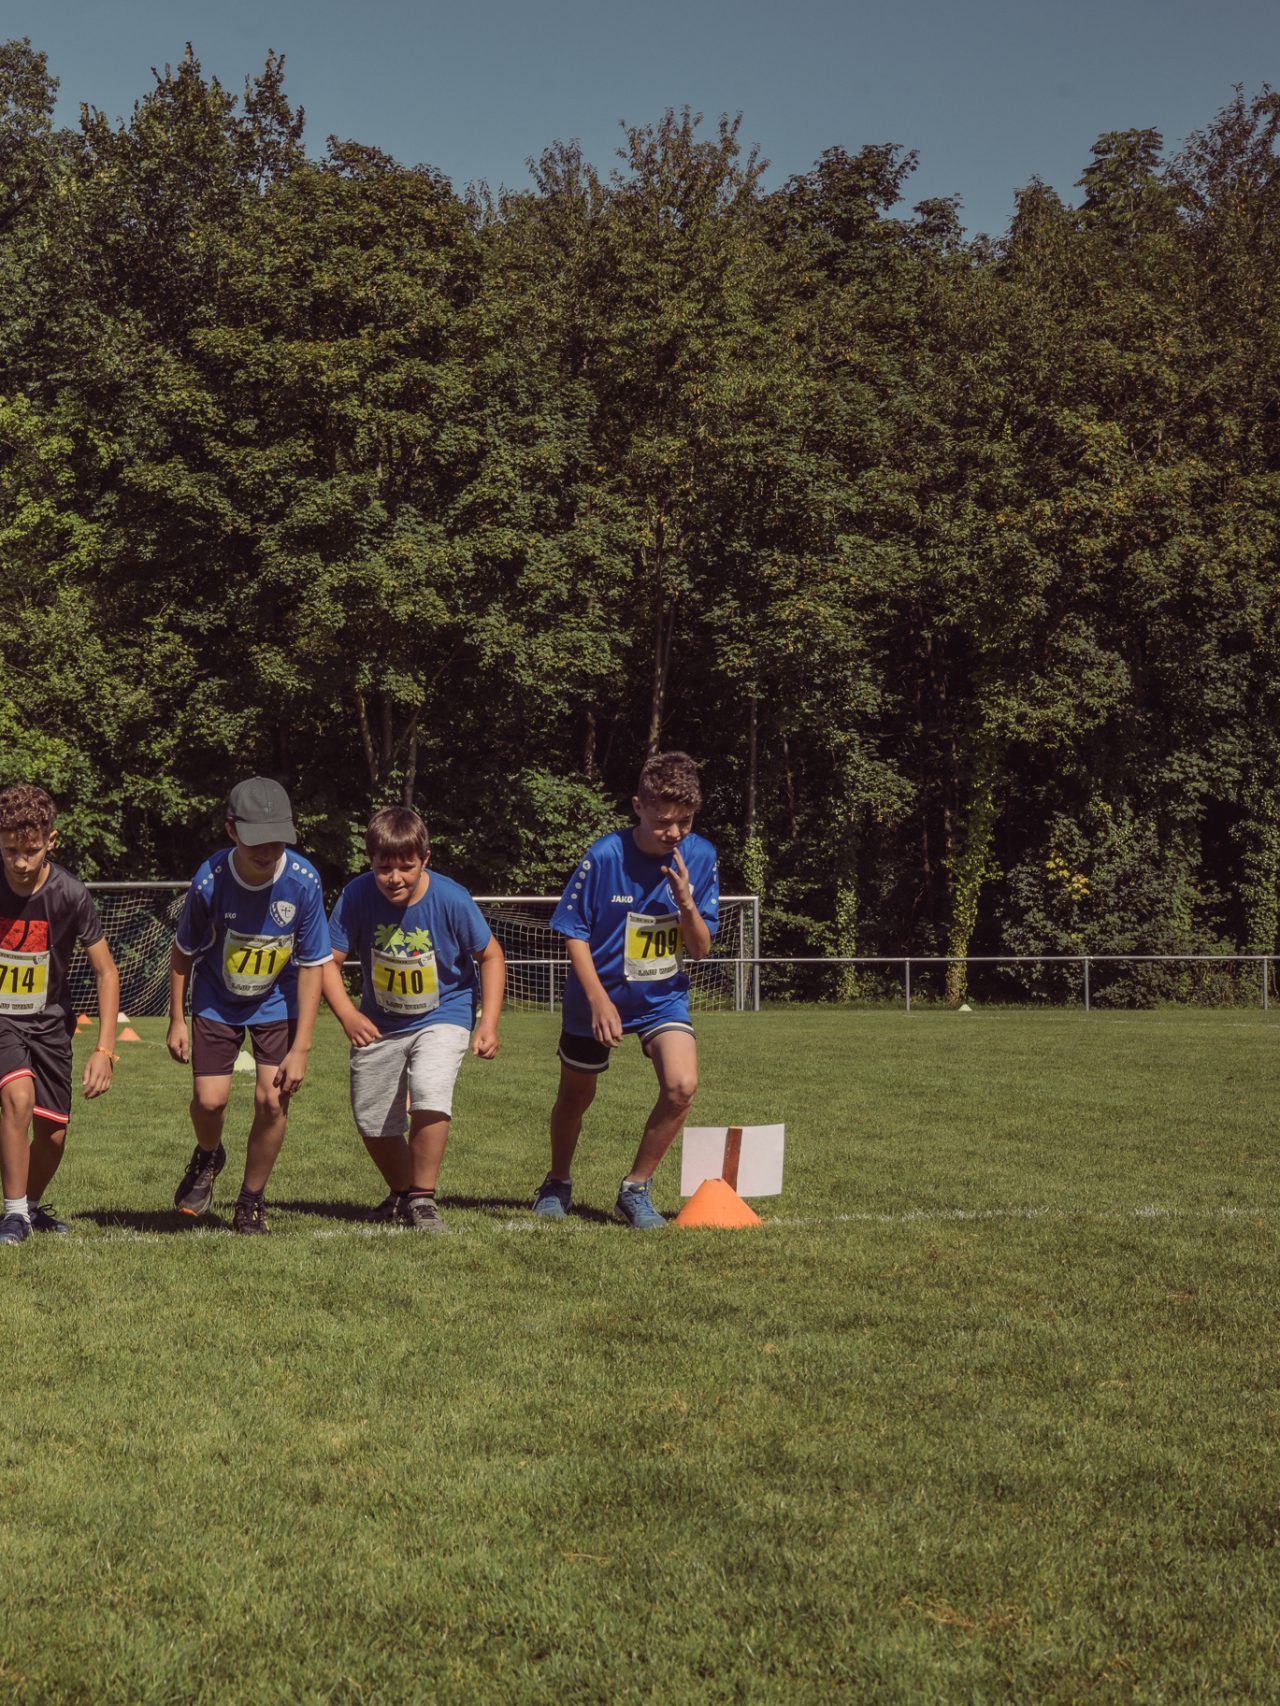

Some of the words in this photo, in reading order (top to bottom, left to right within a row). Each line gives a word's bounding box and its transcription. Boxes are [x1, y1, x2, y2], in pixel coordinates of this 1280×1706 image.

[611, 895, 634, 904] JAKO
[639, 927, 678, 959] 709
[237, 947, 277, 975] 711
[384, 967, 424, 995] 710
